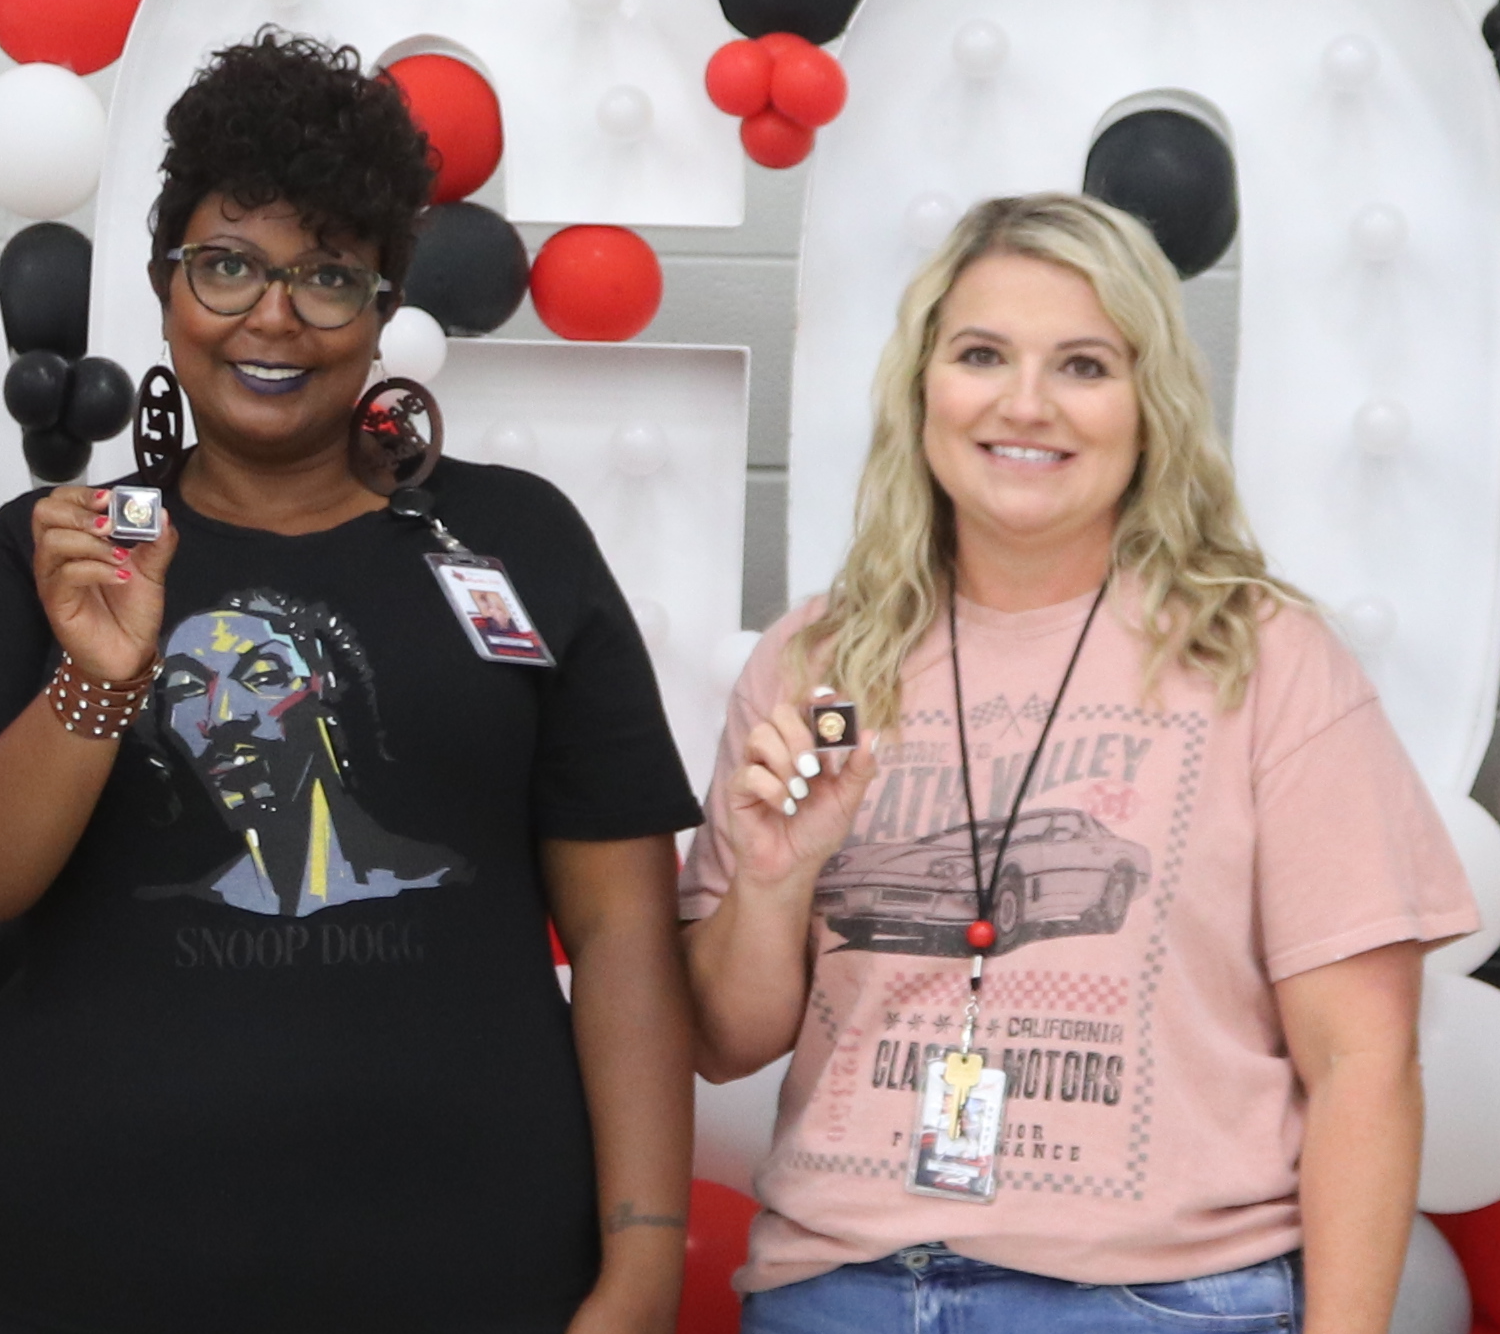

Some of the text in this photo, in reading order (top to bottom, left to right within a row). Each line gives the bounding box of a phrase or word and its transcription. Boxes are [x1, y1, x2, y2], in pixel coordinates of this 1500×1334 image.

[176, 919, 425, 968] SNOOP DOGG
[1007, 1016, 1124, 1046] CALIFORNIA
[1003, 1047, 1123, 1107] MOTORS
